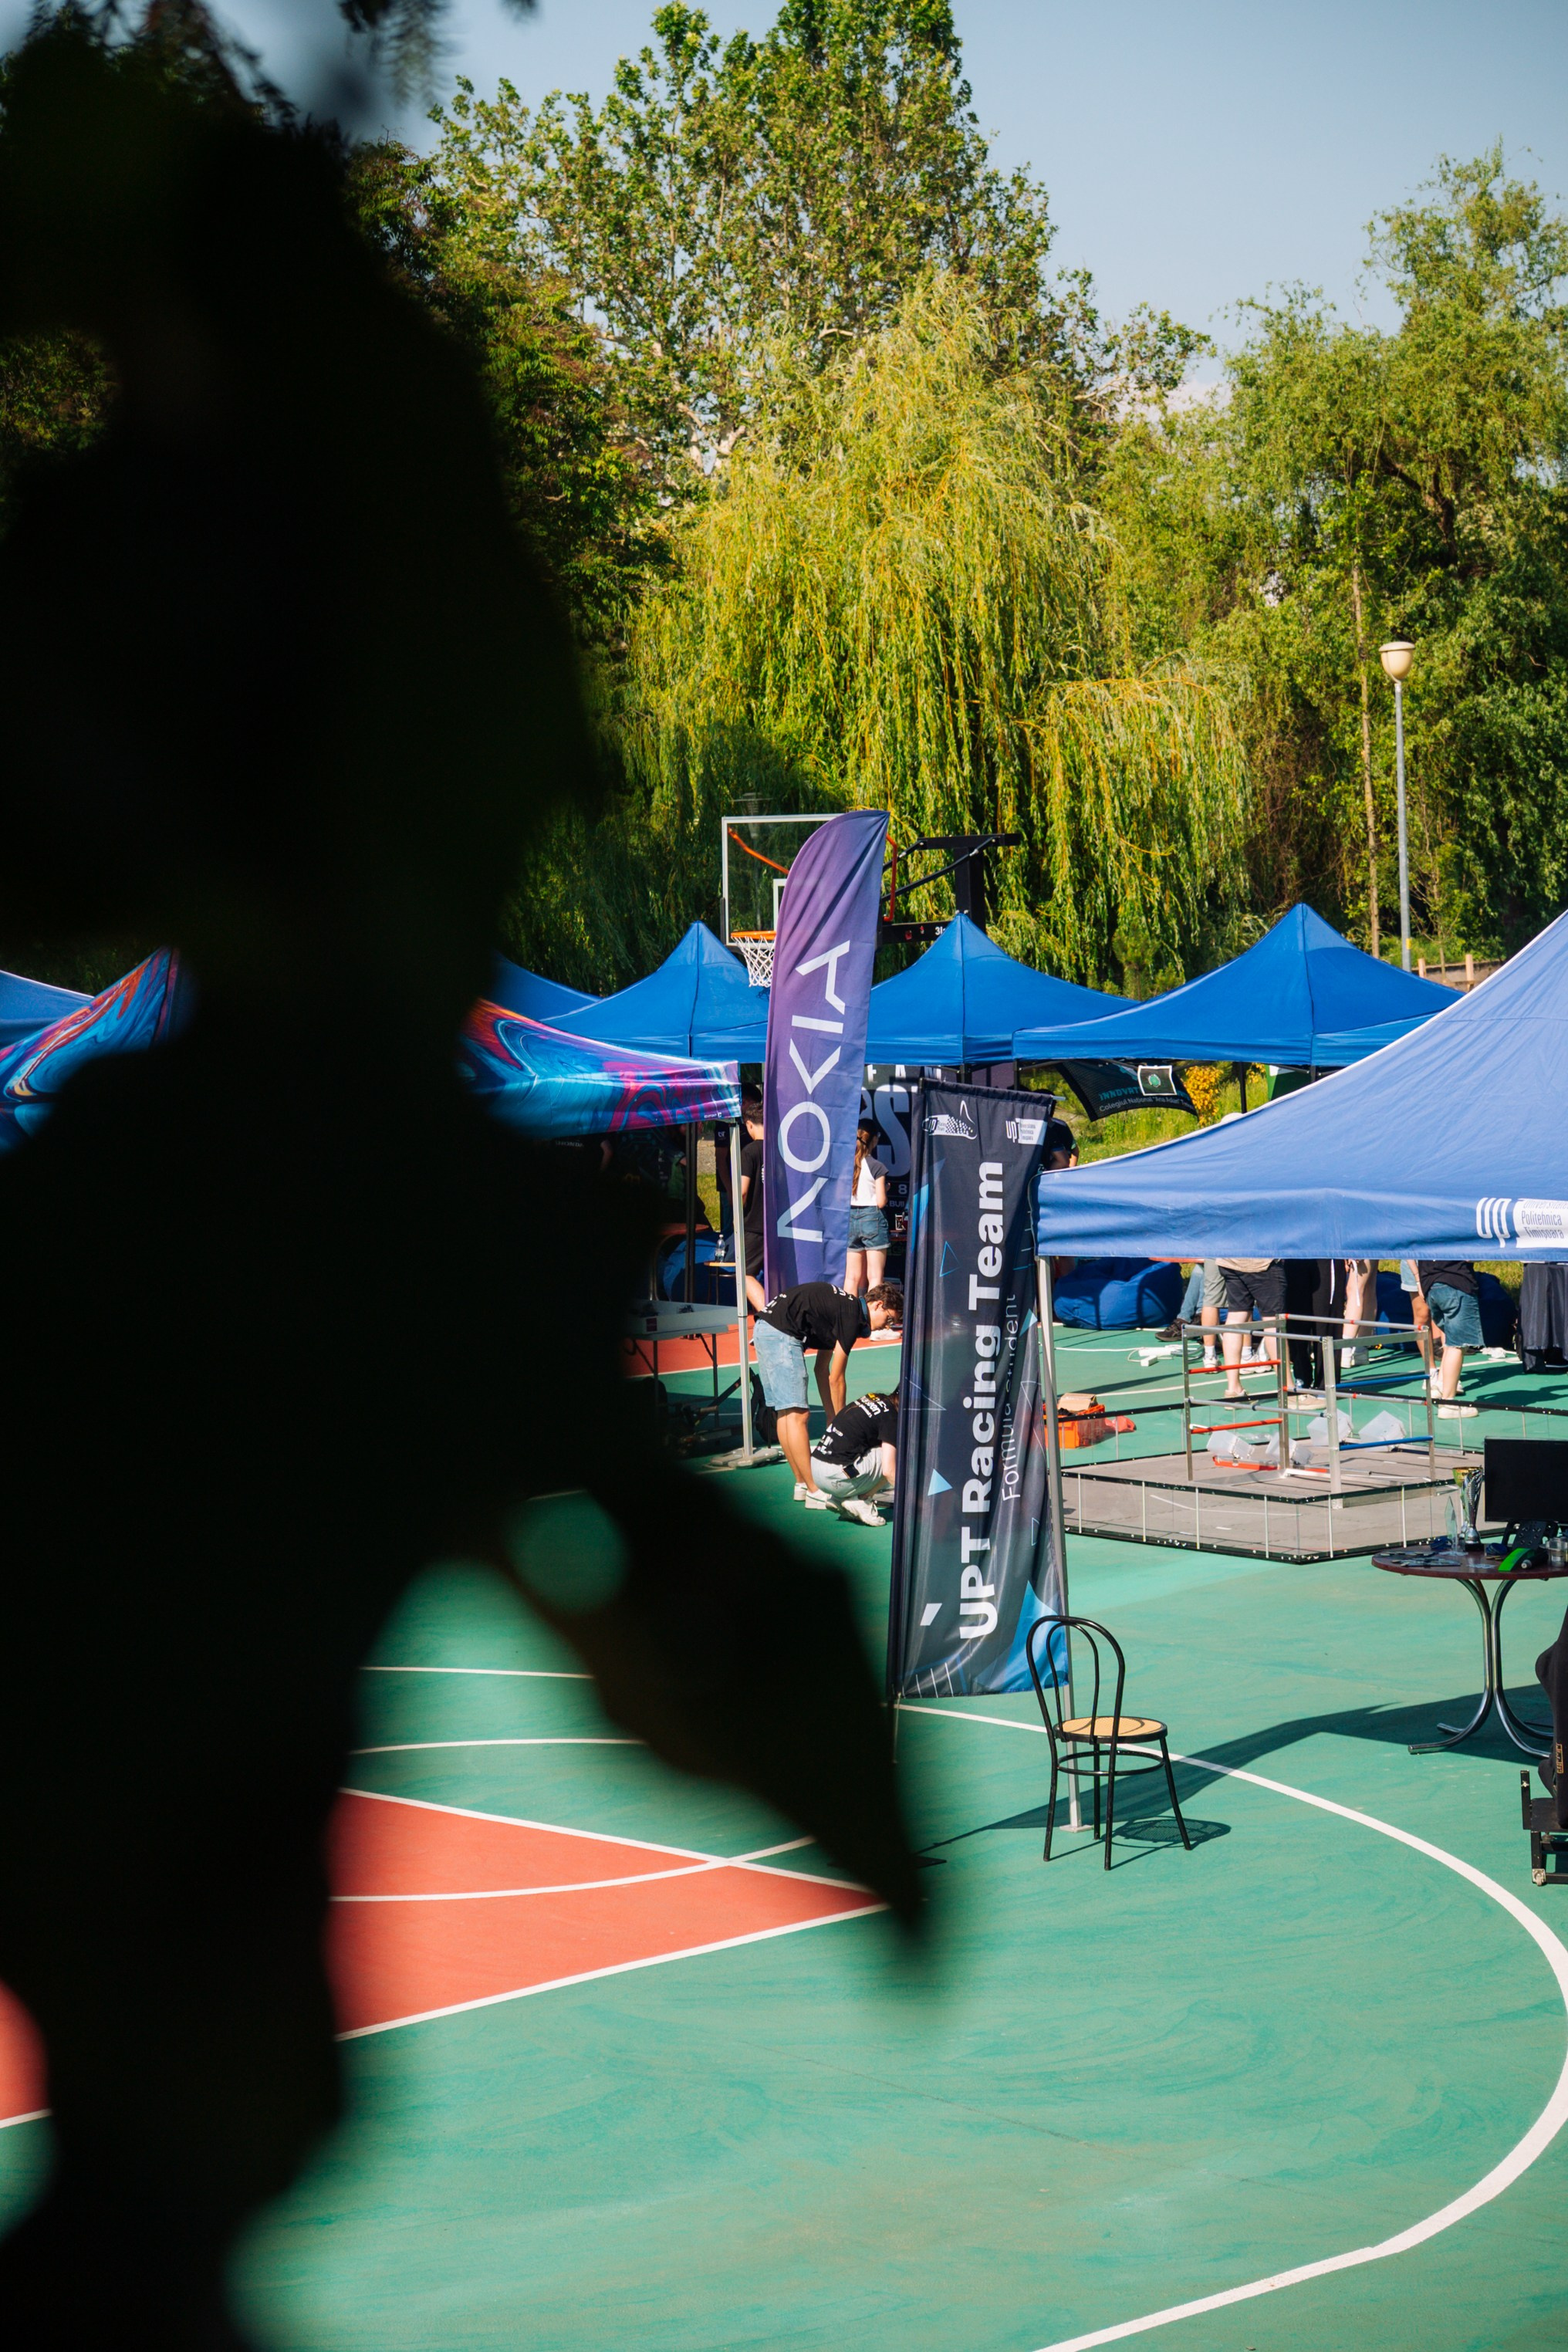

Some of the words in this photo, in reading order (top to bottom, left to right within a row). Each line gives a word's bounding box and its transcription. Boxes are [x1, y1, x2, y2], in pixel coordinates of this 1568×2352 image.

[777, 940, 850, 1242] NOKIA
[968, 1161, 1004, 1310] Team
[1521, 1210, 1563, 1225] Politehnica
[961, 1325, 1001, 1513] Racing
[959, 1527, 999, 1639] UPT
